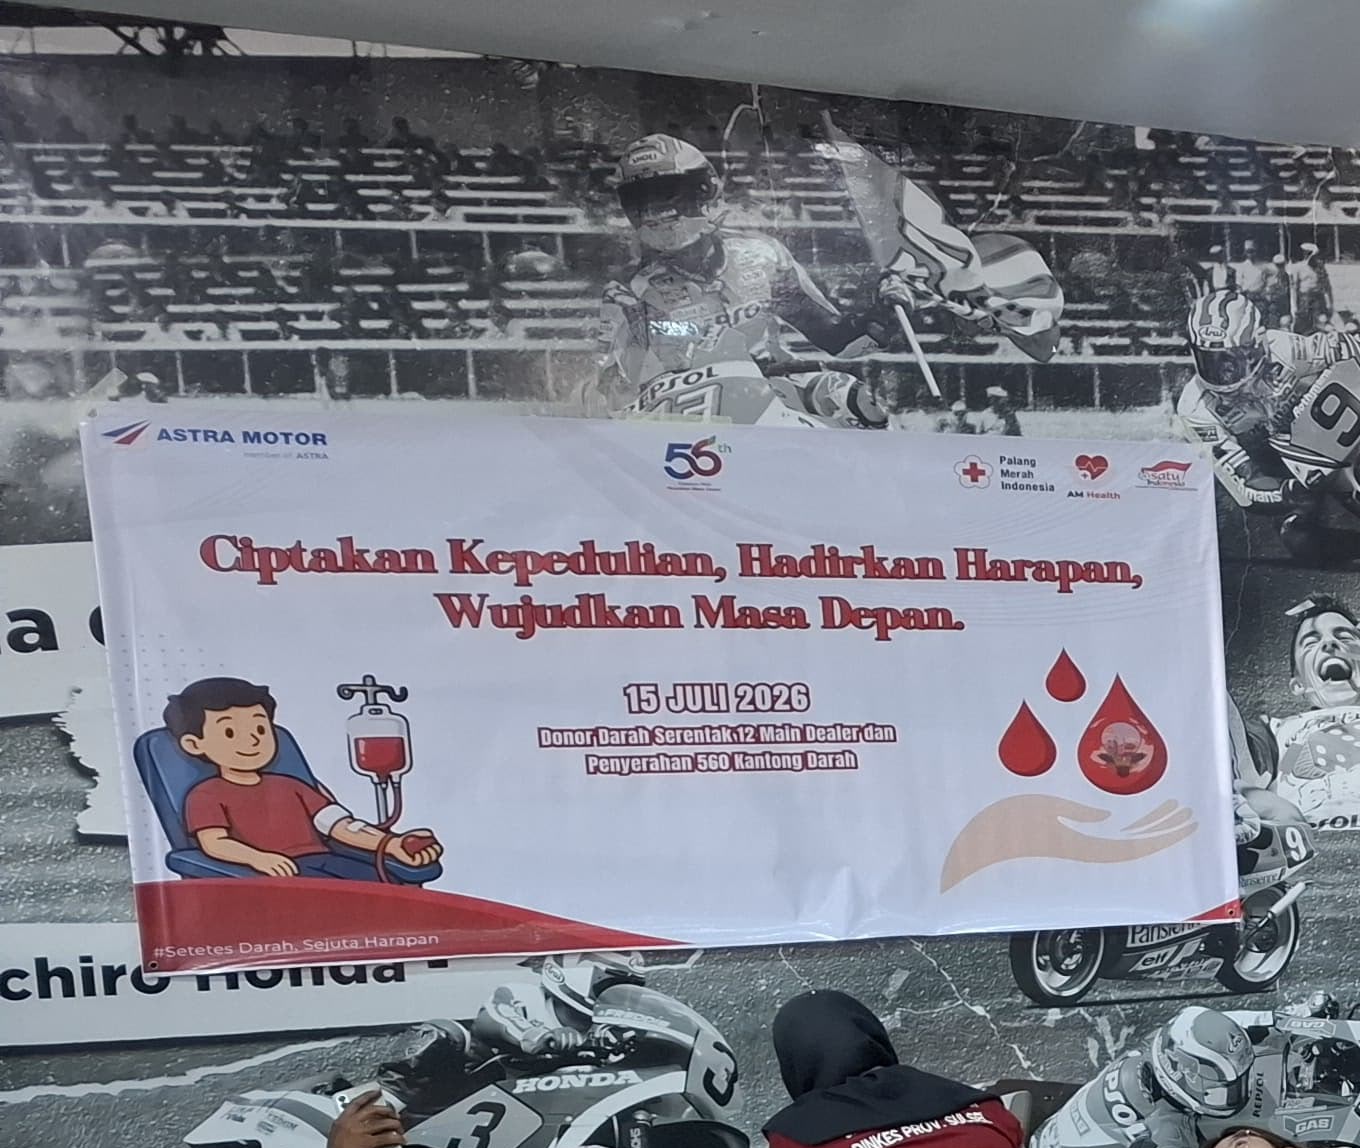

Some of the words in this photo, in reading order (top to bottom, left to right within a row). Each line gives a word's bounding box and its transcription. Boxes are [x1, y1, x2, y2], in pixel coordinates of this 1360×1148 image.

[157, 428, 235, 444] ASTRA
[242, 430, 328, 446] MOTOR
[1000, 456, 1037, 467] Palang
[1000, 469, 1034, 479] Merah
[1000, 482, 1055, 492] Indonesia
[1067, 491, 1084, 499] AM
[1087, 492, 1121, 500] Health
[199, 534, 438, 586] Ciptakan
[446, 538, 727, 587] Kepedulian,
[736, 543, 947, 581] Hadirkan
[953, 547, 1144, 594] Harapan,
[433, 593, 684, 639] Wujudkan
[692, 594, 811, 630] Masa
[818, 595, 966, 642] Depan.
[623, 683, 661, 714] 15
[666, 683, 730, 714] JULI
[736, 682, 811, 713] 2026
[538, 726, 595, 749] Donor
[597, 725, 652, 747] Darah
[653, 725, 734, 747] Serentak
[735, 725, 758, 745] 12
[759, 724, 803, 744] Main
[803, 724, 862, 743] Dealer
[863, 723, 898, 744] dan
[585, 753, 694, 776] Penyerahan
[696, 752, 731, 772] 560
[733, 751, 804, 773] Kantong
[805, 750, 860, 771] Darah
[1285, 827, 1307, 862] 9
[154, 944, 234, 960] #Setetes
[239, 940, 299, 955] Darah,
[303, 938, 359, 953] Sejuta
[364, 933, 439, 949] Harapan
[1140, 950, 1169, 967] elf
[513, 1070, 645, 1094] HONDA
[1252, 1072, 1265, 1118] REPSOL
[1295, 1118, 1330, 1134] GAS
